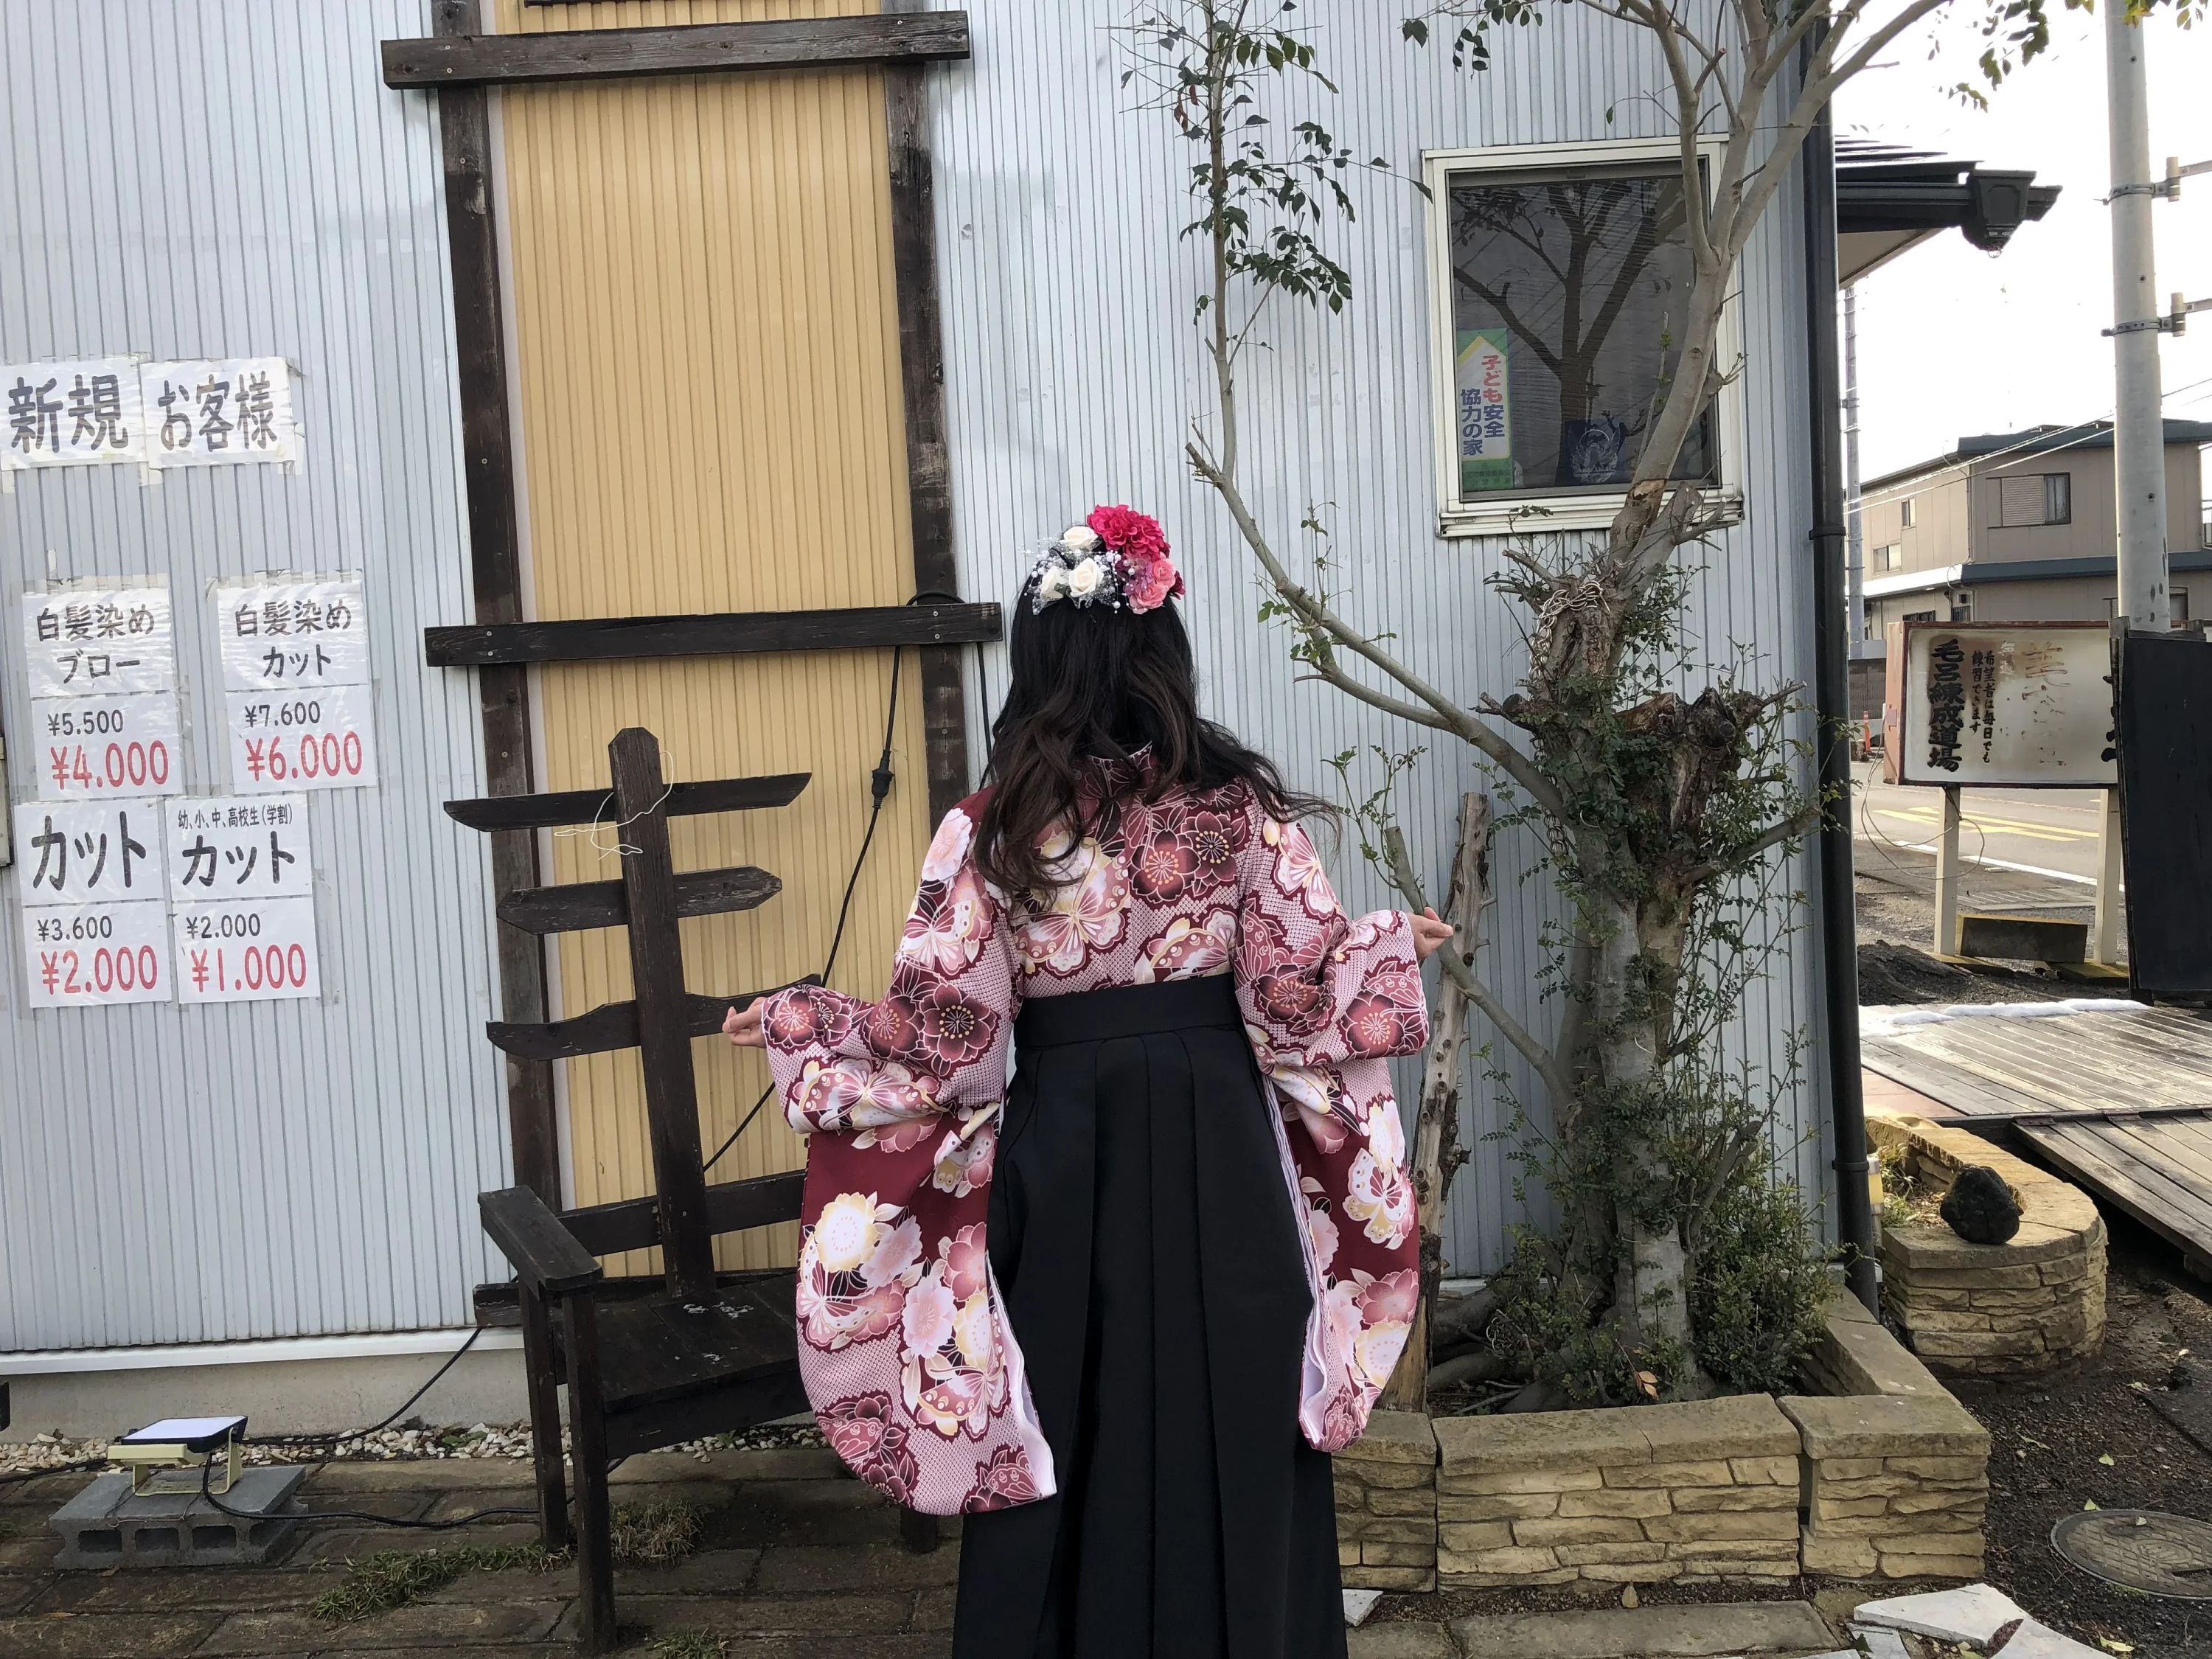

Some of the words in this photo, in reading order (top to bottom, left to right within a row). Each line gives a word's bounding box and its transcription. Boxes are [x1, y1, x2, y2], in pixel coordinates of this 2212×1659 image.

[8, 375, 128, 453] 新規
[158, 371, 276, 452] お客様
[1481, 355, 1505, 438] 子ども安全
[1460, 389, 1483, 456] 協力の家
[37, 603, 154, 641] 白髪染め
[235, 599, 352, 637] 白髪染め
[57, 650, 141, 684] ブロー
[263, 644, 331, 678] カット
[48, 709, 124, 736] ¥5.500
[245, 701, 321, 727] ¥7.600
[1927, 639, 1965, 772] 毛呂練成道場
[1982, 650, 1996, 763] 希望者は毎日でも
[51, 740, 169, 790] ¥4.000
[246, 731, 363, 782] ¥6.000
[31, 811, 147, 891] カット
[182, 830, 295, 886] カット
[38, 915, 112, 942] ¥3.600
[187, 913, 261, 939] ¥2.000
[41, 945, 158, 995] ¥2.000
[191, 943, 306, 992] ¥1.000
